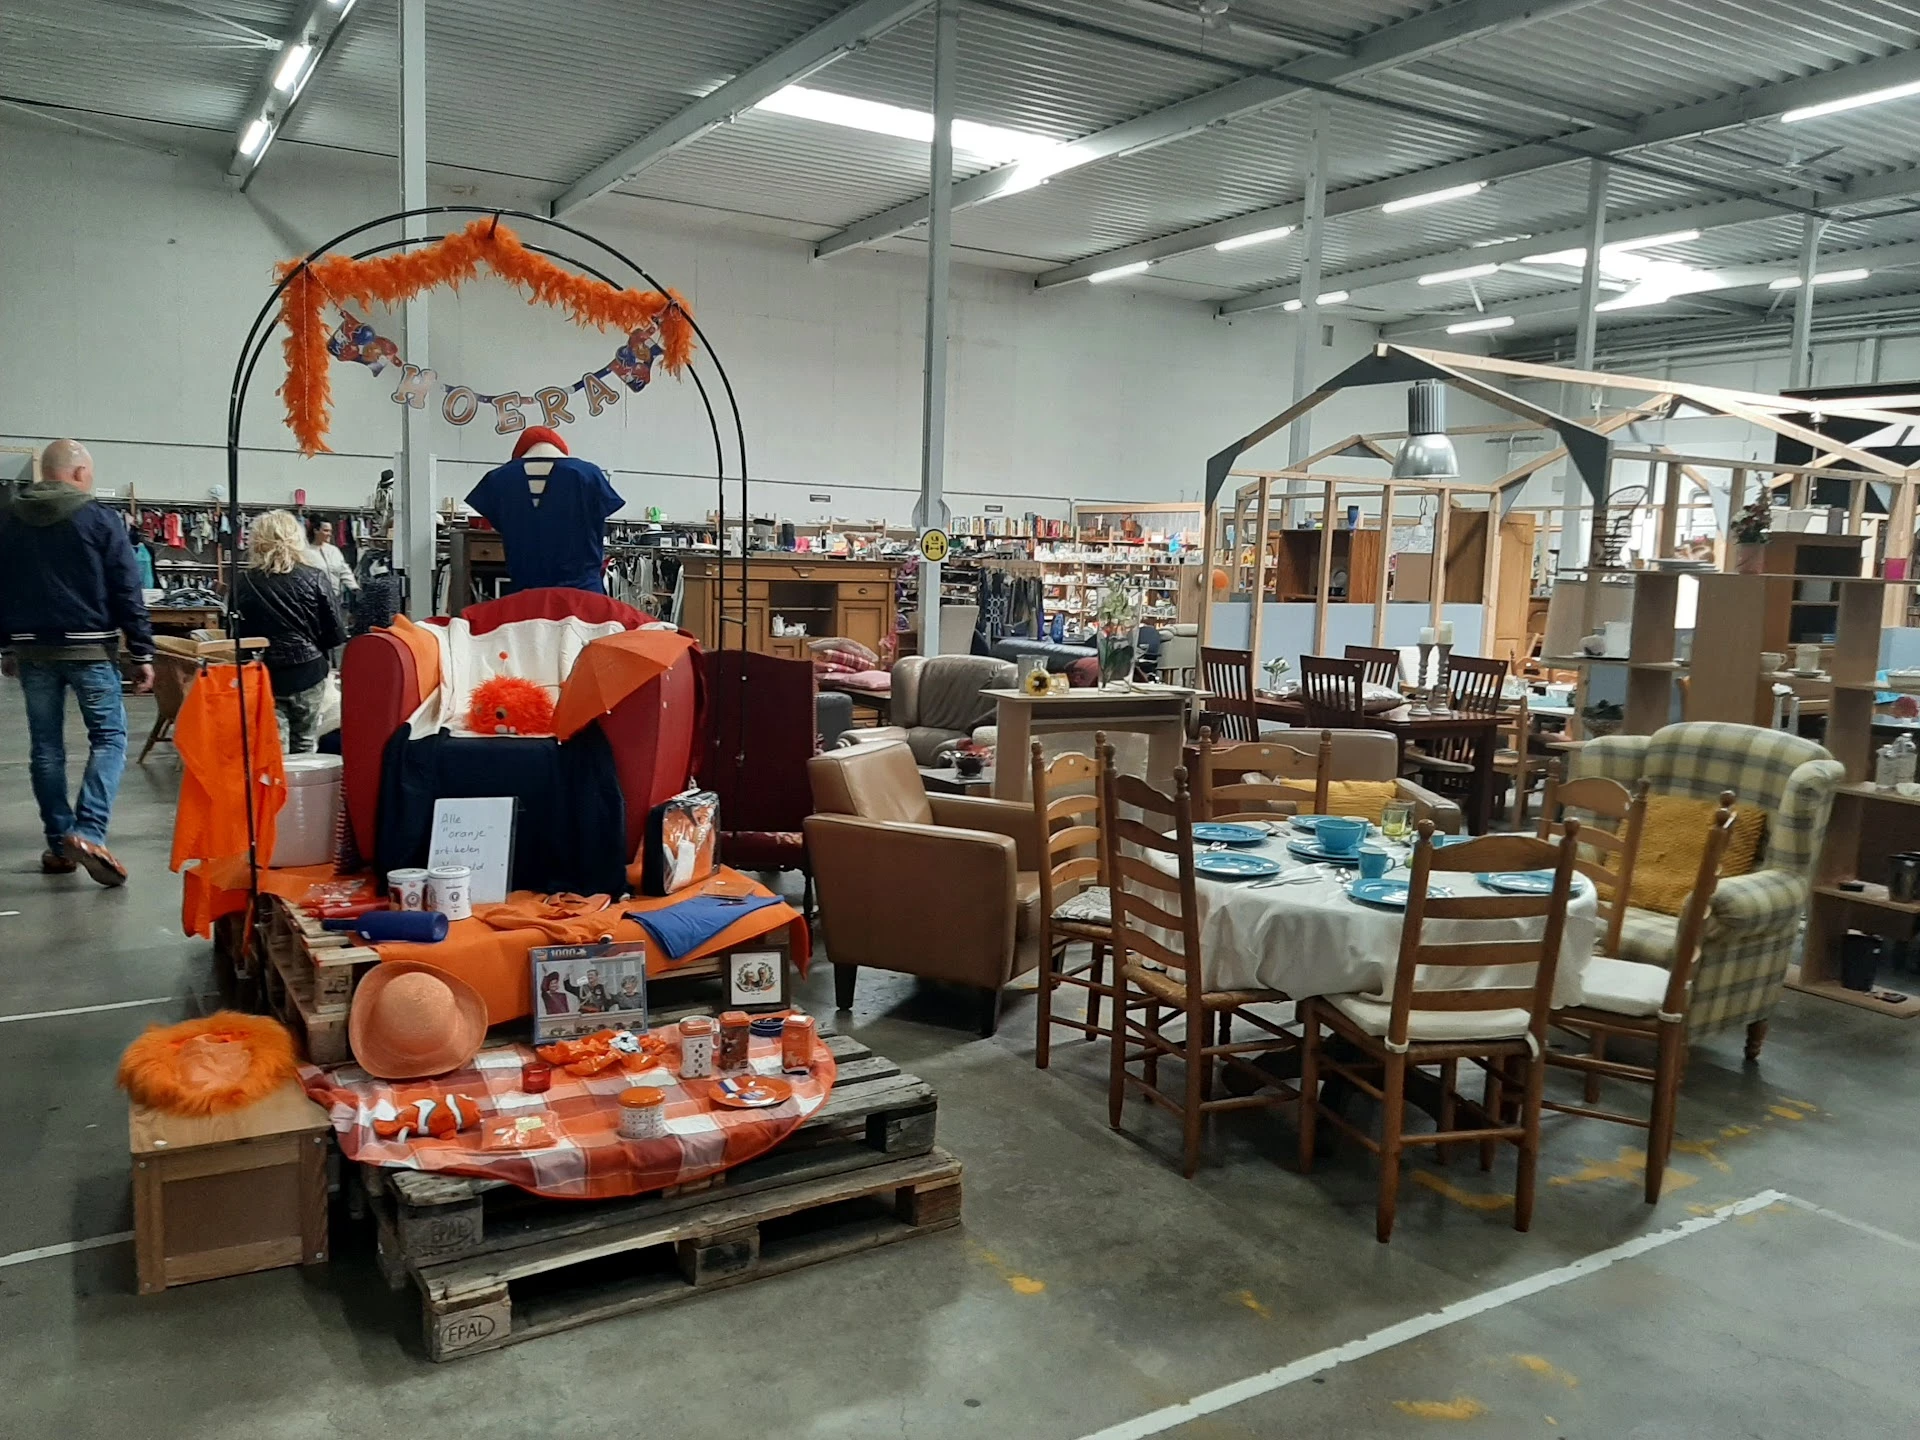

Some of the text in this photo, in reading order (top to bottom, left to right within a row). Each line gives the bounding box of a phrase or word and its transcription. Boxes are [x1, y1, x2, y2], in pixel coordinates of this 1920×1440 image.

[391, 363, 620, 434] HOERA
[440, 812, 462, 824] Alle
[550, 948, 576, 957] 1000
